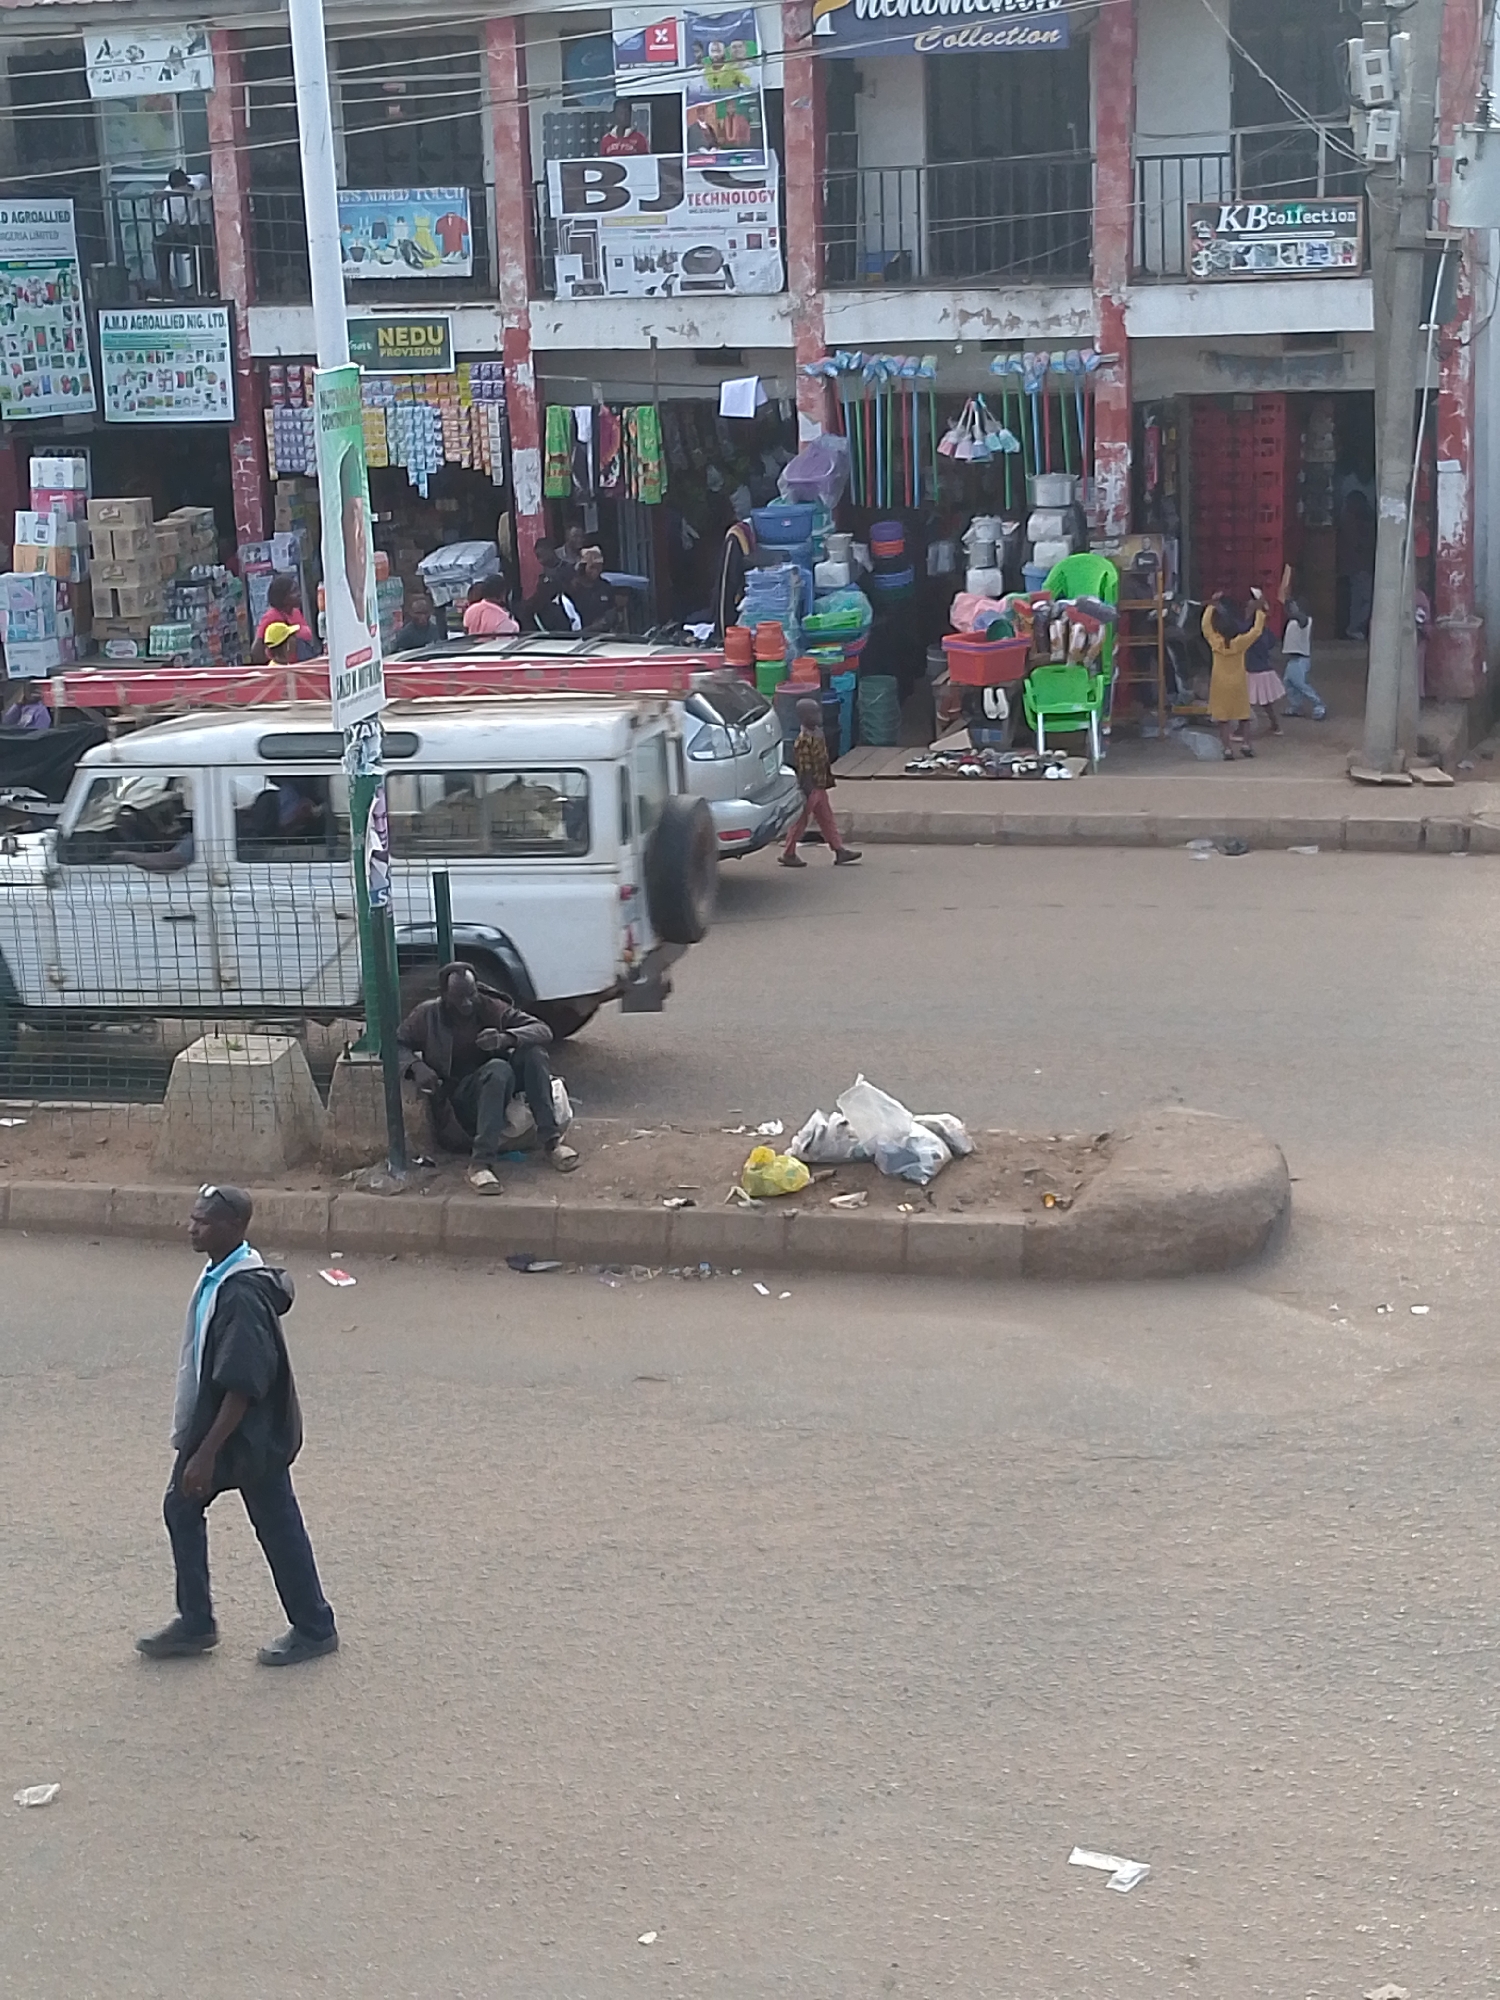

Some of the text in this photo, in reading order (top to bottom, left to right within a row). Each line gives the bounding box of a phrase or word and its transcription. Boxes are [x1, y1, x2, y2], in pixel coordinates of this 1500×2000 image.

[914, 26, 1060, 52] Collection
[686, 189, 776, 207] TECHNOLOGY
[11, 210, 71, 224] AGROALLIED
[1215, 204, 1357, 232] KB Collection
[29, 229, 60, 241] LIMITED
[130, 314, 185, 330] AGROALLIED
[376, 325, 444, 348] NEDU
[379, 345, 442, 358] PROVISION
